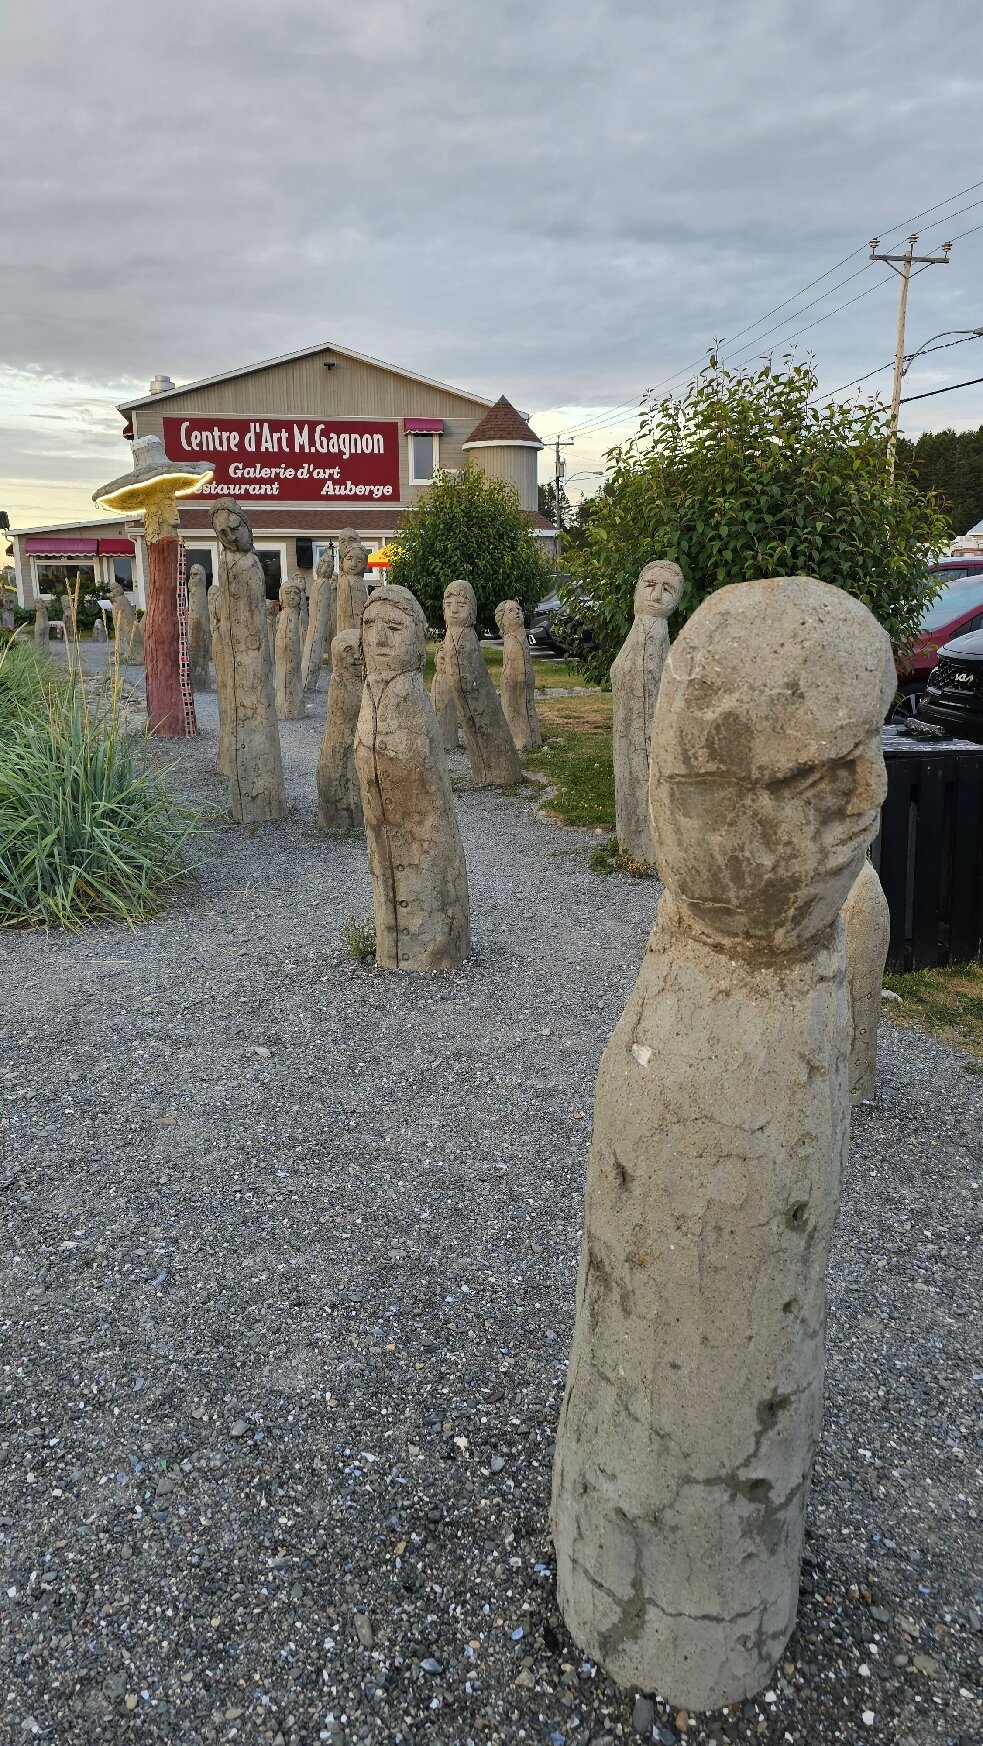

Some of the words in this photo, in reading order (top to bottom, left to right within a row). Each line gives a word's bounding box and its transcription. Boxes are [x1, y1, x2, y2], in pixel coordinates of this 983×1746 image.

[180, 421, 239, 451] Centre
[244, 423, 289, 453] d'Art
[228, 463, 295, 479] Galerie
[297, 463, 341, 479] d'art
[194, 480, 280, 495] estaurant
[320, 480, 393, 497] Auberge
